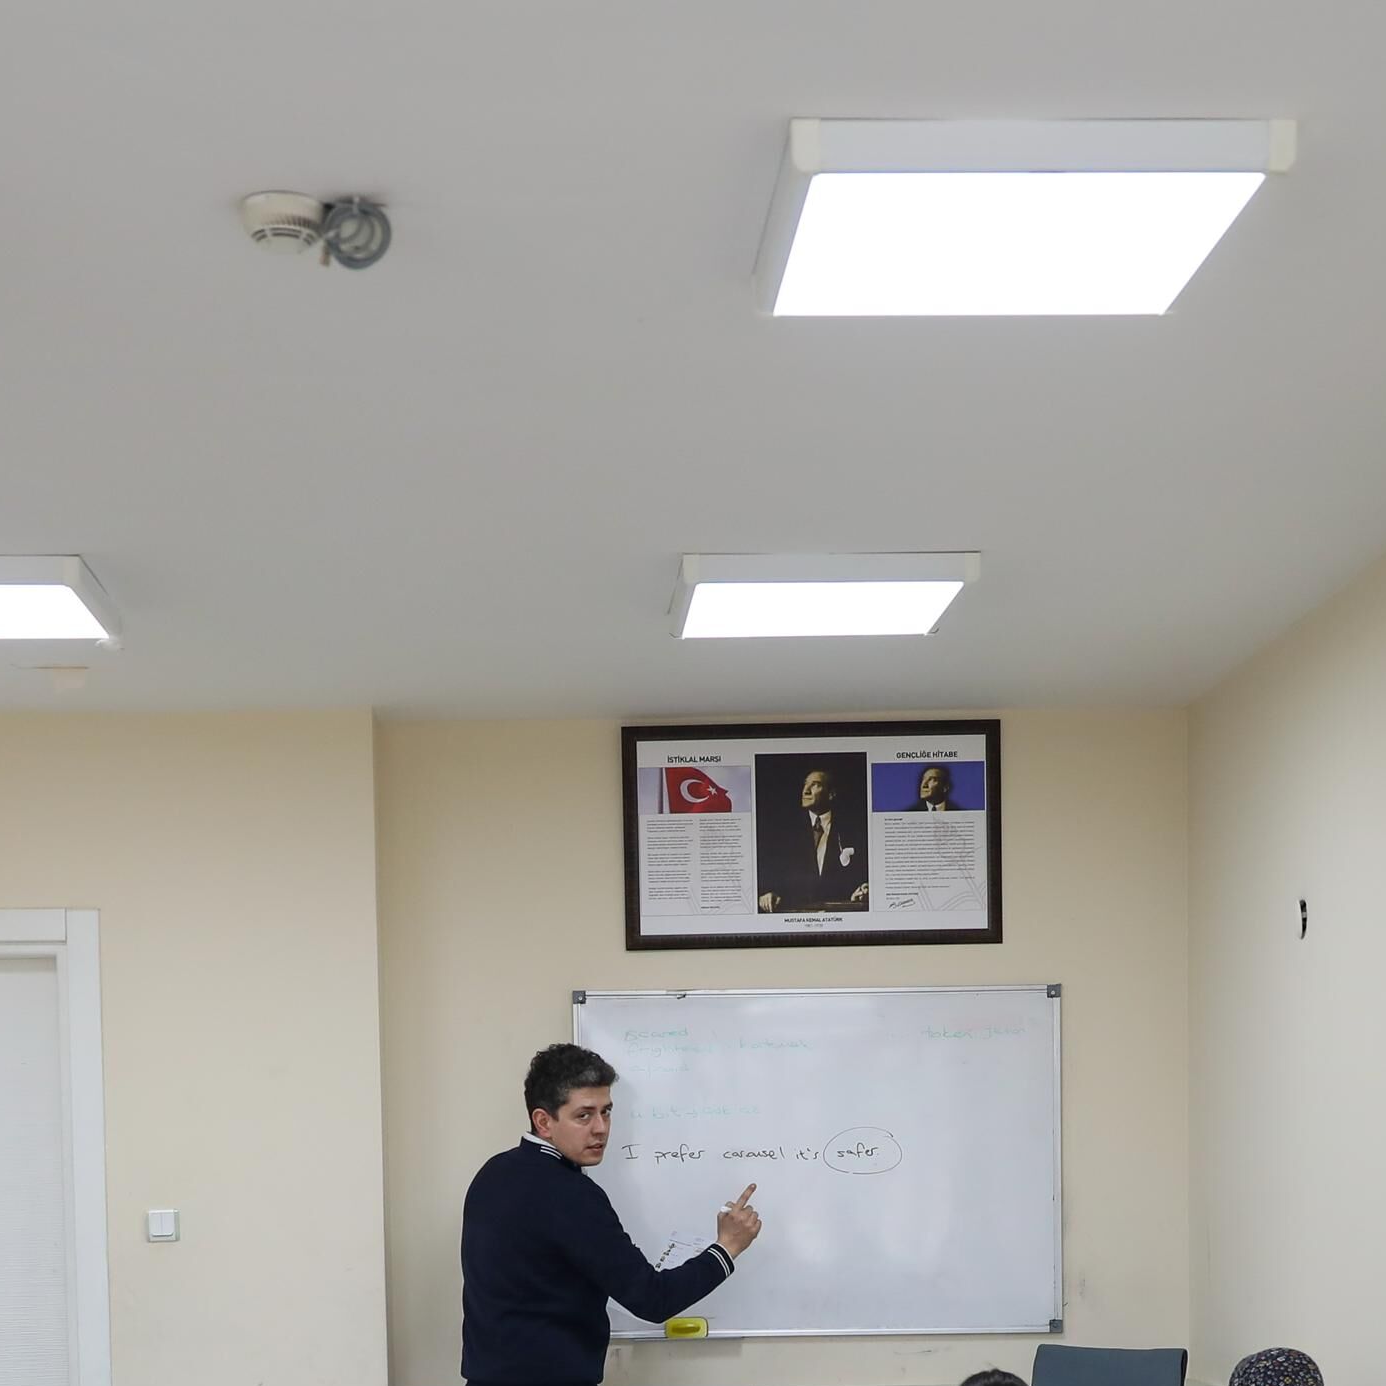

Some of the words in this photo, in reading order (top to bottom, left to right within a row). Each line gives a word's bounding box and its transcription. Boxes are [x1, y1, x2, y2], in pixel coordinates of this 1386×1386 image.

[621, 1143, 642, 1160] I
[654, 1143, 705, 1165] prefer
[723, 1146, 785, 1160] carousel
[796, 1147, 820, 1161] it's
